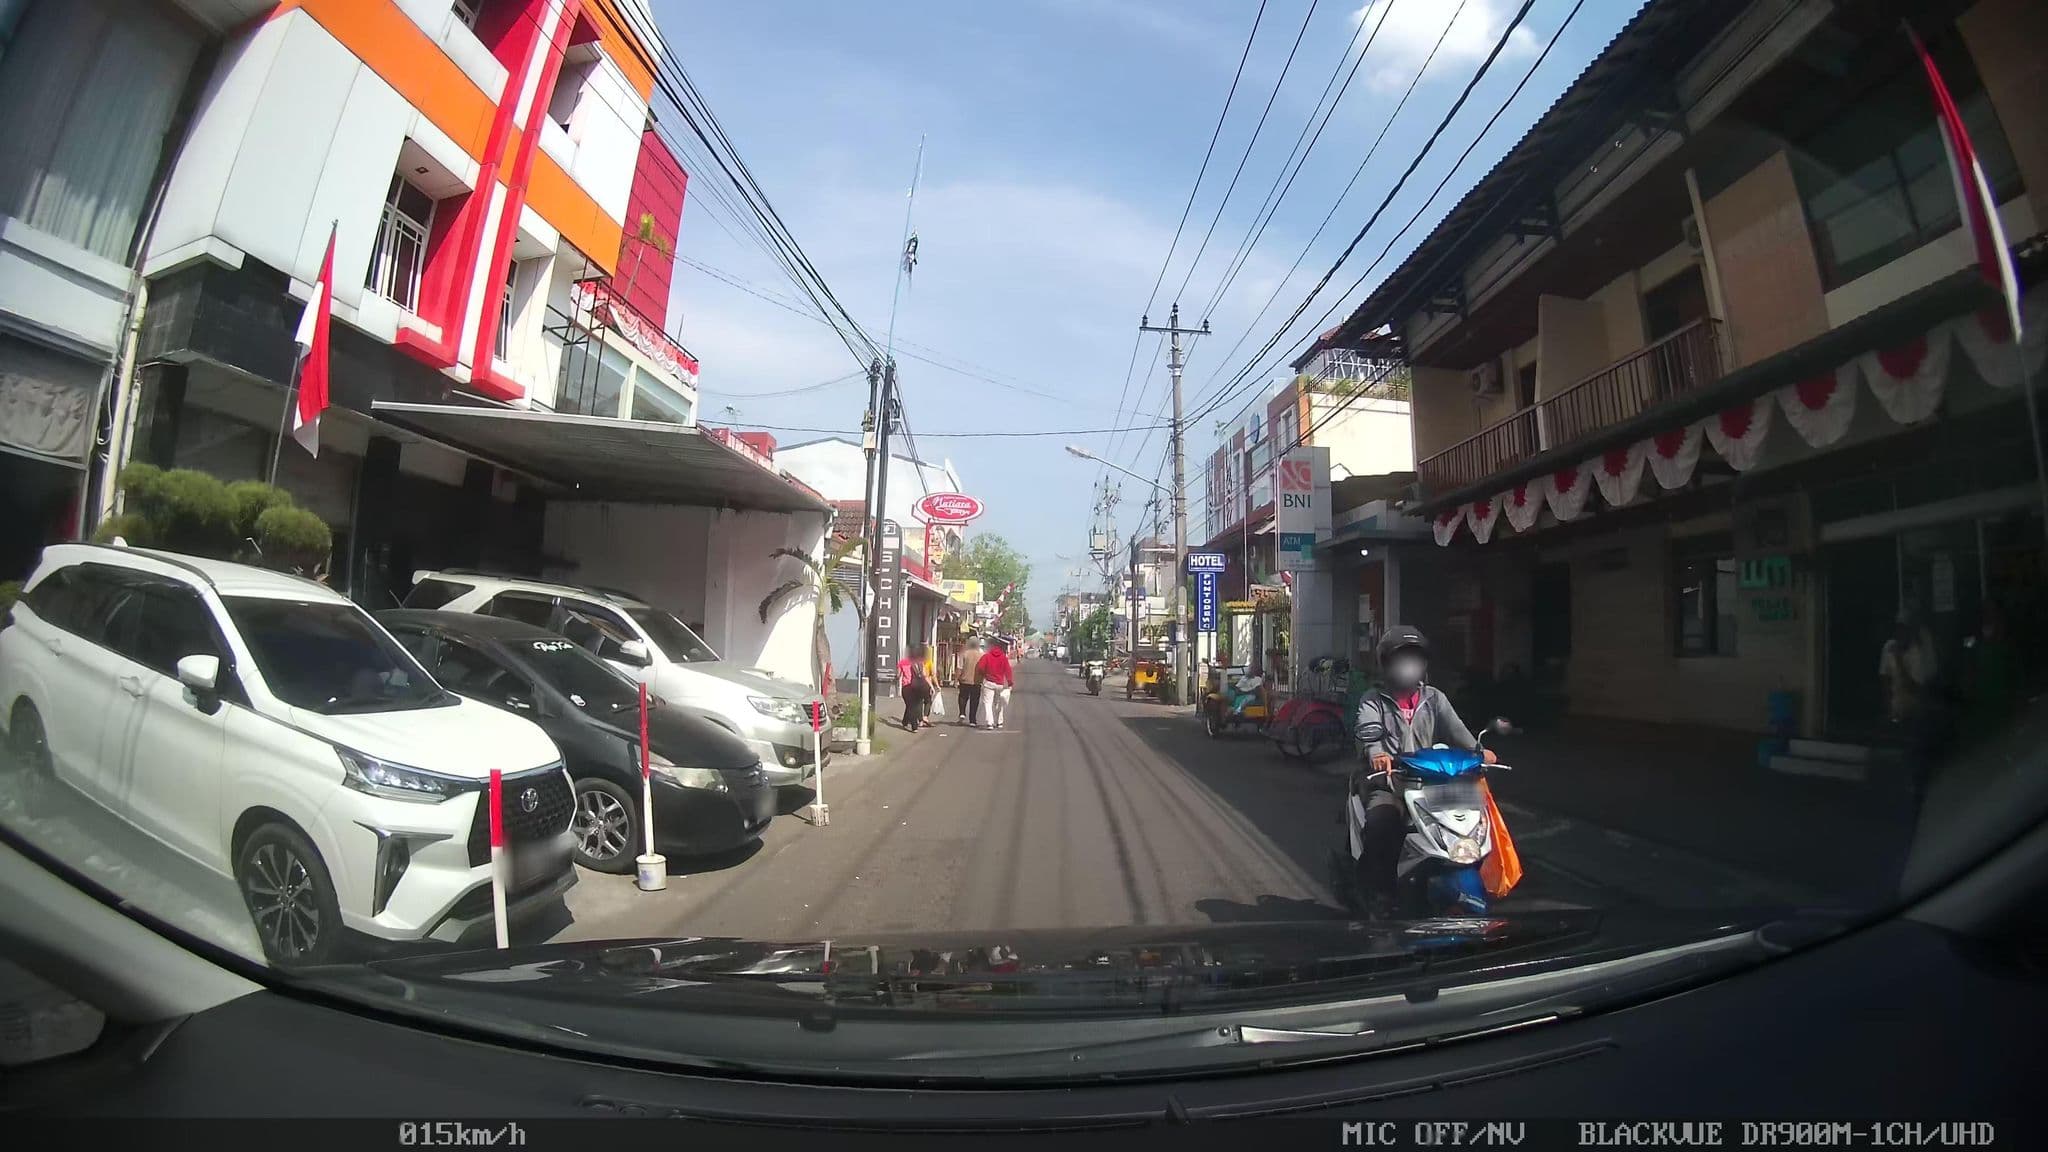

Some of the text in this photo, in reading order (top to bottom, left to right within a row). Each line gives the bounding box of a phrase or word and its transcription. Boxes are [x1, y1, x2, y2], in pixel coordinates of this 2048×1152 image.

[1283, 493, 1312, 509] BNI
[1283, 536, 1301, 546] ATM
[1190, 555, 1223, 567] HOTEL
